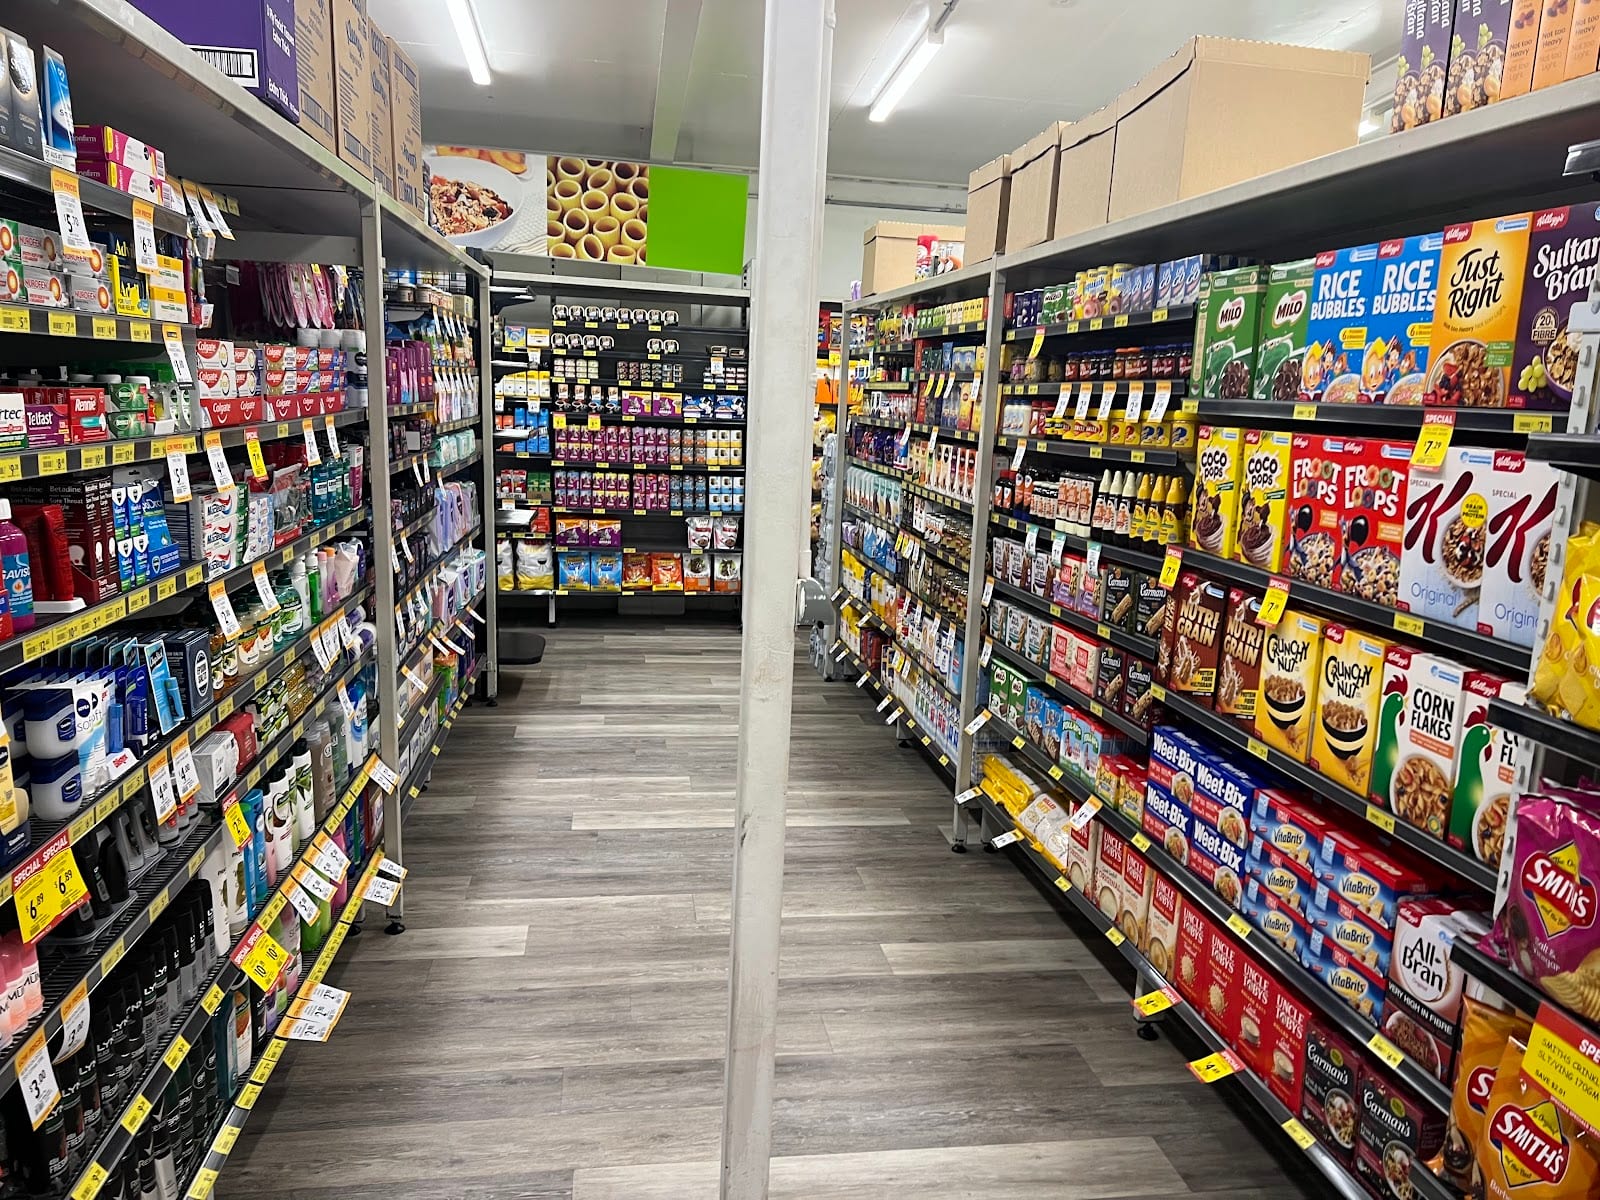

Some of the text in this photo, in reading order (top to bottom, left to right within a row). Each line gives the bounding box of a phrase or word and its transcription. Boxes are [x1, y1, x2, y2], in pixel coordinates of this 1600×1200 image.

[20, 236, 41, 248] NUROFEN
[1382, 259, 1434, 294] RICE
[1451, 248, 1500, 287] Just
[25, 280, 48, 288] NUROFEN
[75, 291, 96, 299] NUROFEN
[1319, 269, 1362, 301] RICE
[1372, 290, 1437, 315] BUBBLES
[1448, 273, 1504, 319] Right
[1220, 306, 1241, 324] MILO
[1276, 300, 1302, 319] MILO
[1311, 297, 1365, 320] BUBBLES
[1533, 329, 1555, 340] FIBRE
[198, 341, 217, 352] Colgate
[198, 370, 218, 382] Colgate
[75, 398, 96, 411] Rennie
[212, 402, 231, 415] Colgate
[240, 400, 256, 411] Colgate
[275, 399, 291, 409] Colgate
[27, 412, 53, 426] Telfast
[1424, 414, 1452, 424] SPECIAL
[1201, 450, 1227, 467] COCO
[1248, 456, 1278, 475] COCO
[1204, 466, 1223, 480] pops
[1252, 473, 1273, 488] pops
[1410, 478, 1431, 488] SPECIAL
[1492, 489, 1517, 499] SPECIAL
[1462, 511, 1484, 520] PROTEIN
[1465, 503, 1483, 511] GRAIN
[1411, 582, 1458, 606] Original
[1177, 617, 1216, 647] GRAIN
[1224, 635, 1258, 667] GRAIN
[1267, 633, 1310, 664] CRUNCHY
[1277, 655, 1296, 672] NUT
[1325, 656, 1373, 690] CRUNCHY
[1337, 680, 1360, 699] NUT
[1413, 687, 1455, 723] CORN
[1411, 711, 1451, 741] FLAKES
[1154, 733, 1197, 776] Weet-Bix
[179, 763, 190, 780] $4.00
[156, 782, 167, 799] $4.00
[1197, 762, 1247, 812] Weet-Bix
[1147, 785, 1189, 832] Weet-Bix
[1192, 819, 1244, 873] Weet-Bix
[1274, 829, 1303, 845] VitaBrits
[13, 858, 41, 887] SPECIAL
[42, 835, 68, 862] SPECIAL
[54, 869, 73, 894] $6.89
[1157, 878, 1175, 899] UNCLE
[1267, 873, 1296, 890] VitaBrits
[1341, 878, 1376, 897] VitaBrits
[26, 893, 44, 919] $6.89
[1155, 890, 1174, 911] TOBYS
[1184, 907, 1204, 928] UNCLE
[1263, 915, 1291, 932] VitaBrits
[1183, 919, 1203, 944] TOBYS
[1335, 928, 1371, 946] VitaBrits
[1212, 934, 1235, 957] UNCLE
[1412, 937, 1442, 967] All-
[1211, 947, 1234, 974] TOBYS
[1402, 945, 1443, 992] Bran
[1244, 962, 1269, 990] UNCLE
[1330, 973, 1366, 993] VitaBrits
[1243, 975, 1268, 1005] TOBYS
[1277, 994, 1304, 1023] UNCLE
[1389, 982, 1453, 1035] VERY HIGH IN FIBRE
[1276, 1006, 1303, 1039] TOBYS
[1542, 1038, 1571, 1064] SMITHS
[1308, 1042, 1348, 1085] Carman's
[29, 1069, 46, 1099] $3.00
[1535, 1069, 1549, 1085] SAVE
[1538, 1050, 1599, 1101] SLT/VING 170GM
[1364, 1089, 1411, 1138] Carman's
[1496, 1111, 1564, 1175] SMITH'S
